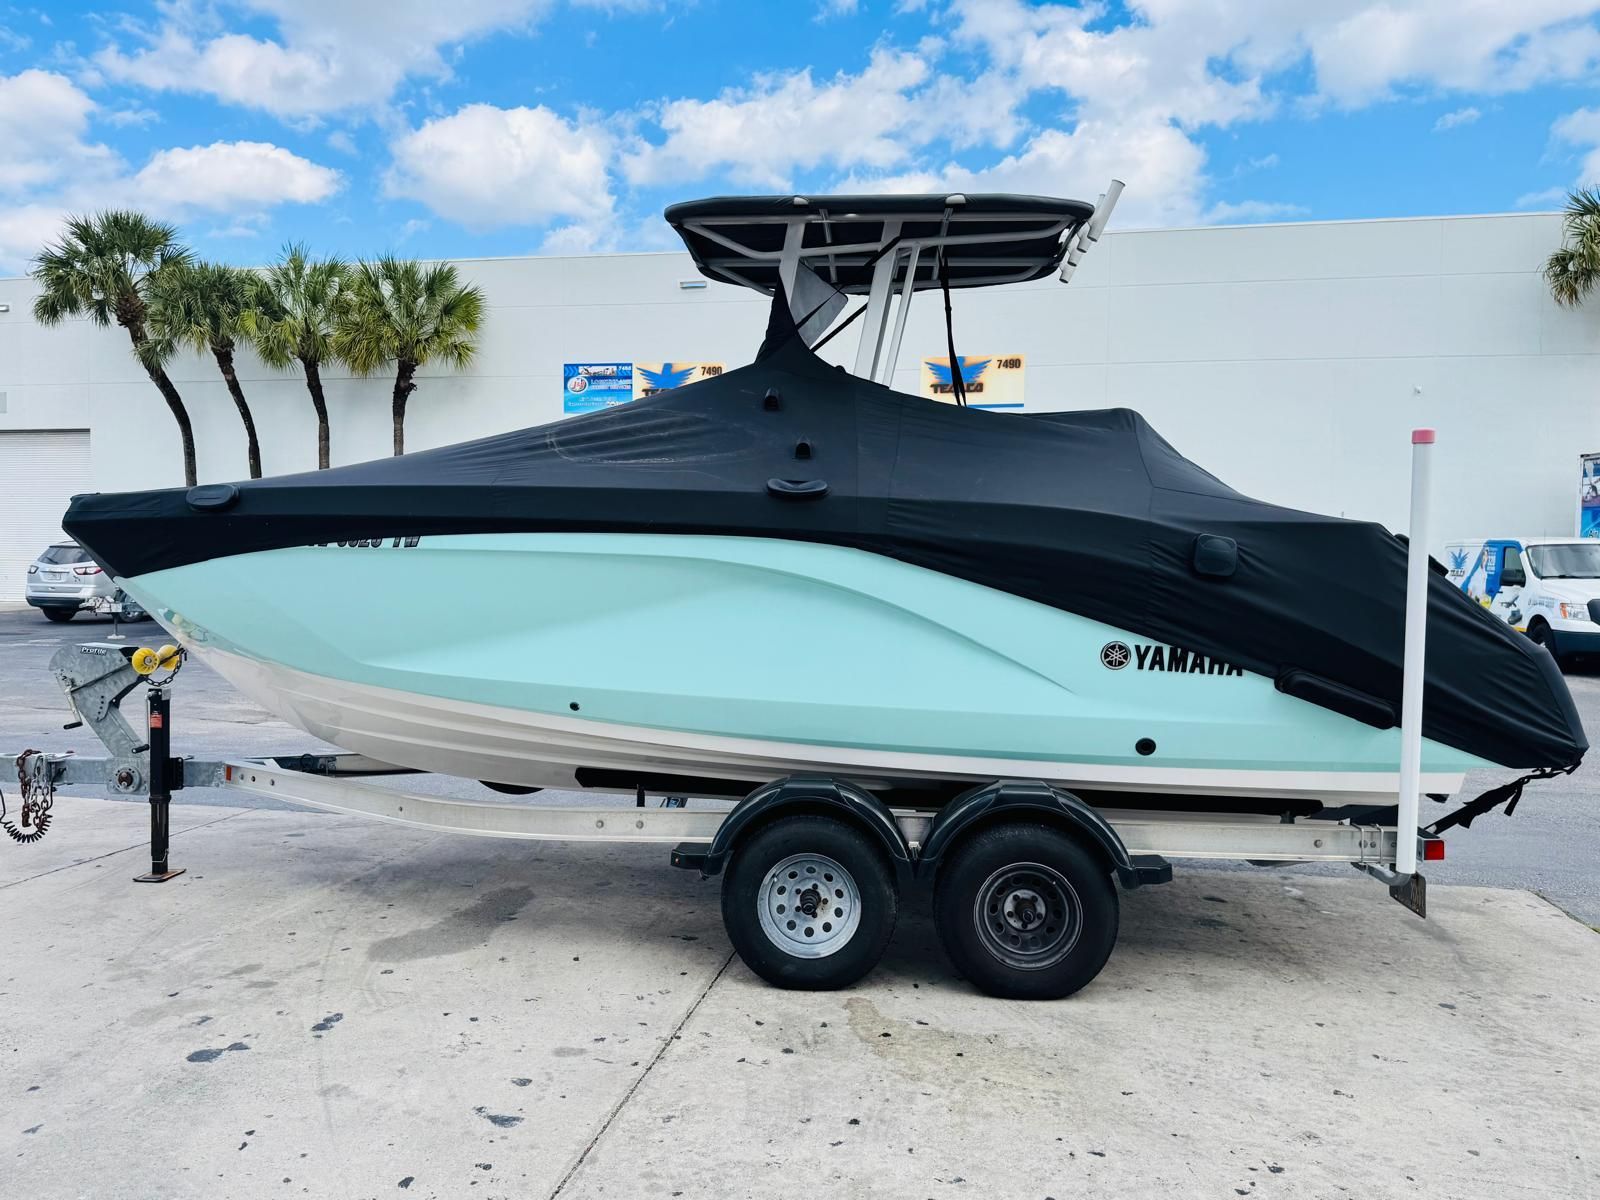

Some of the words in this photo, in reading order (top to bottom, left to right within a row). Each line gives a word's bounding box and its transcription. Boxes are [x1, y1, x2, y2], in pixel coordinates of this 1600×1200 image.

[997, 359, 1021, 369] 7490
[701, 366, 723, 376] 7490
[81, 646, 107, 655] Profile
